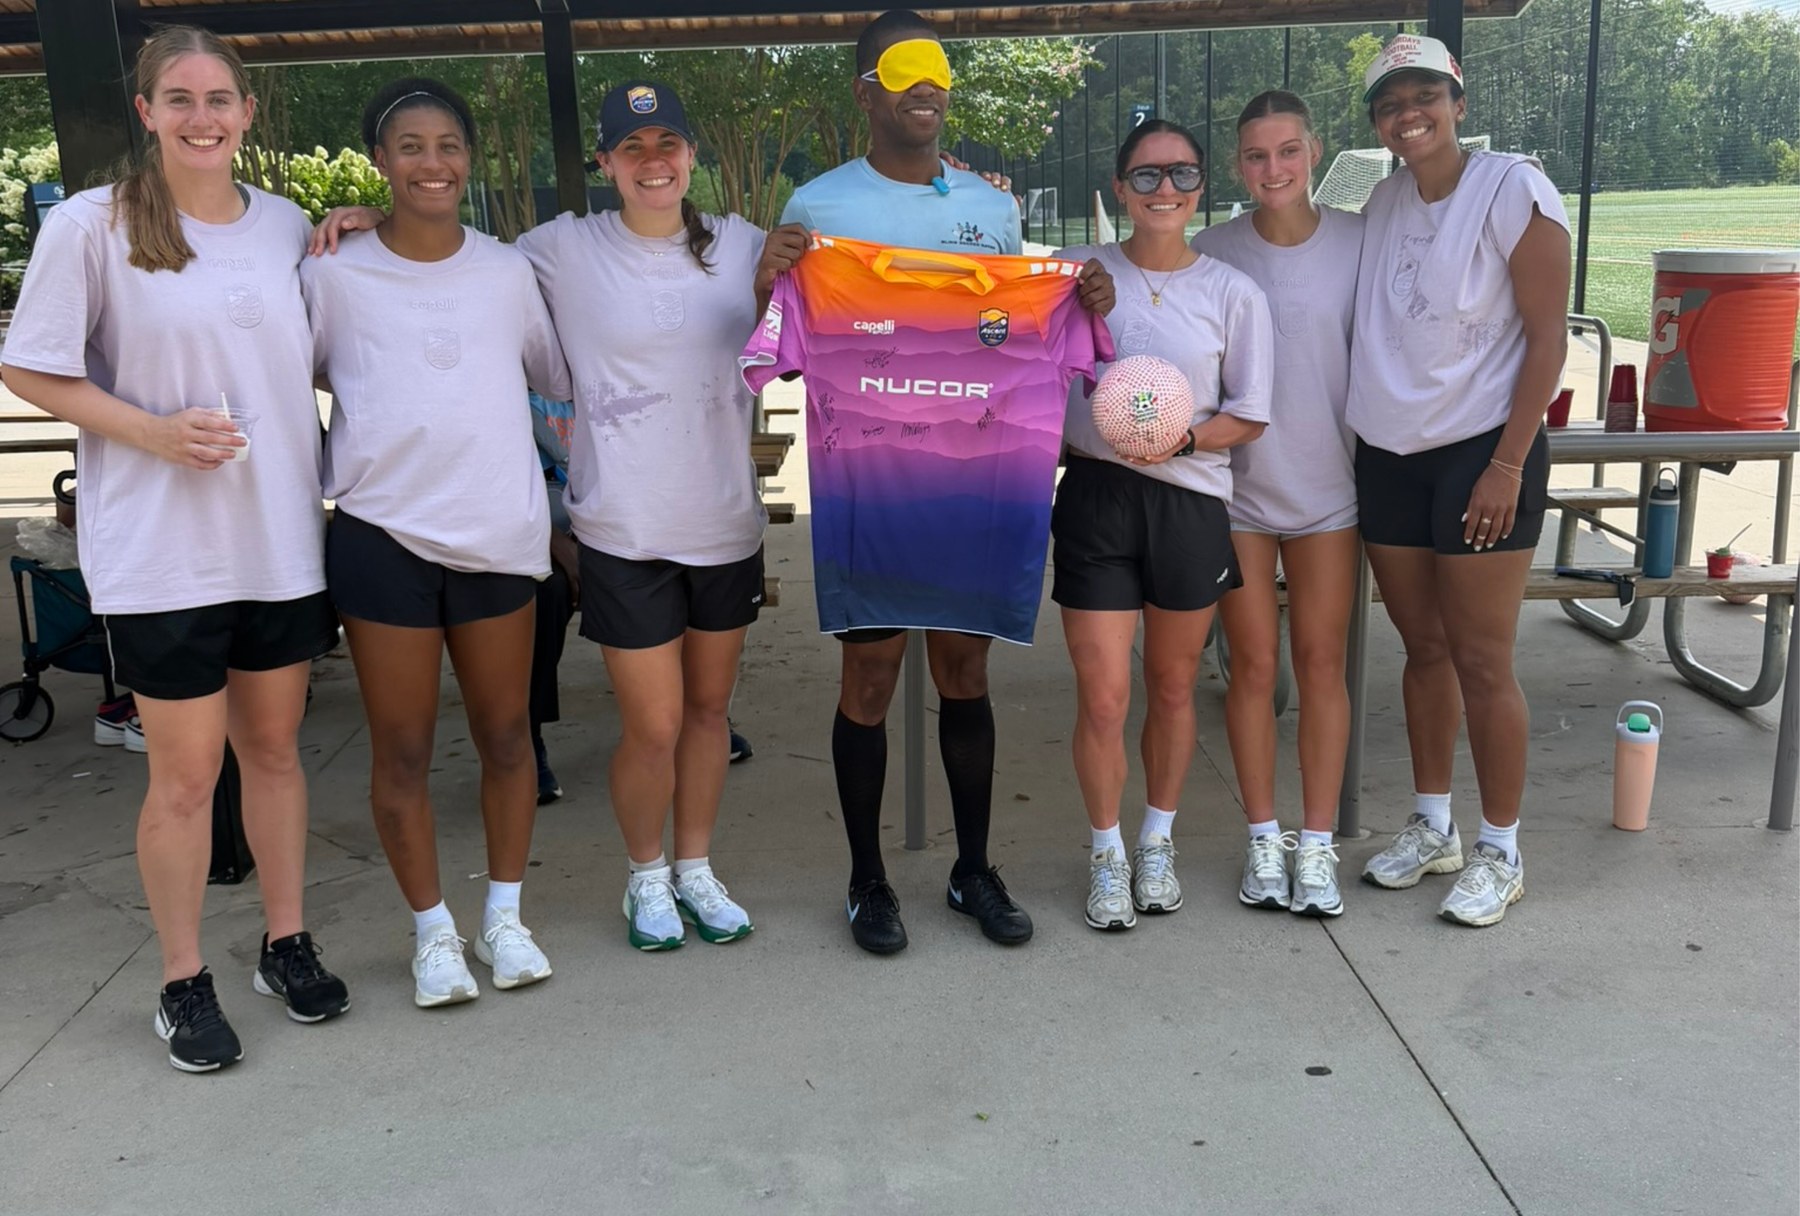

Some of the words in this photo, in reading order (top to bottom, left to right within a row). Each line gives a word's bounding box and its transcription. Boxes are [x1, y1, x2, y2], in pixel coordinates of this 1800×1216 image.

[853, 319, 895, 334] capelli
[1649, 296, 1681, 355] G
[860, 376, 988, 399] NUCOR
